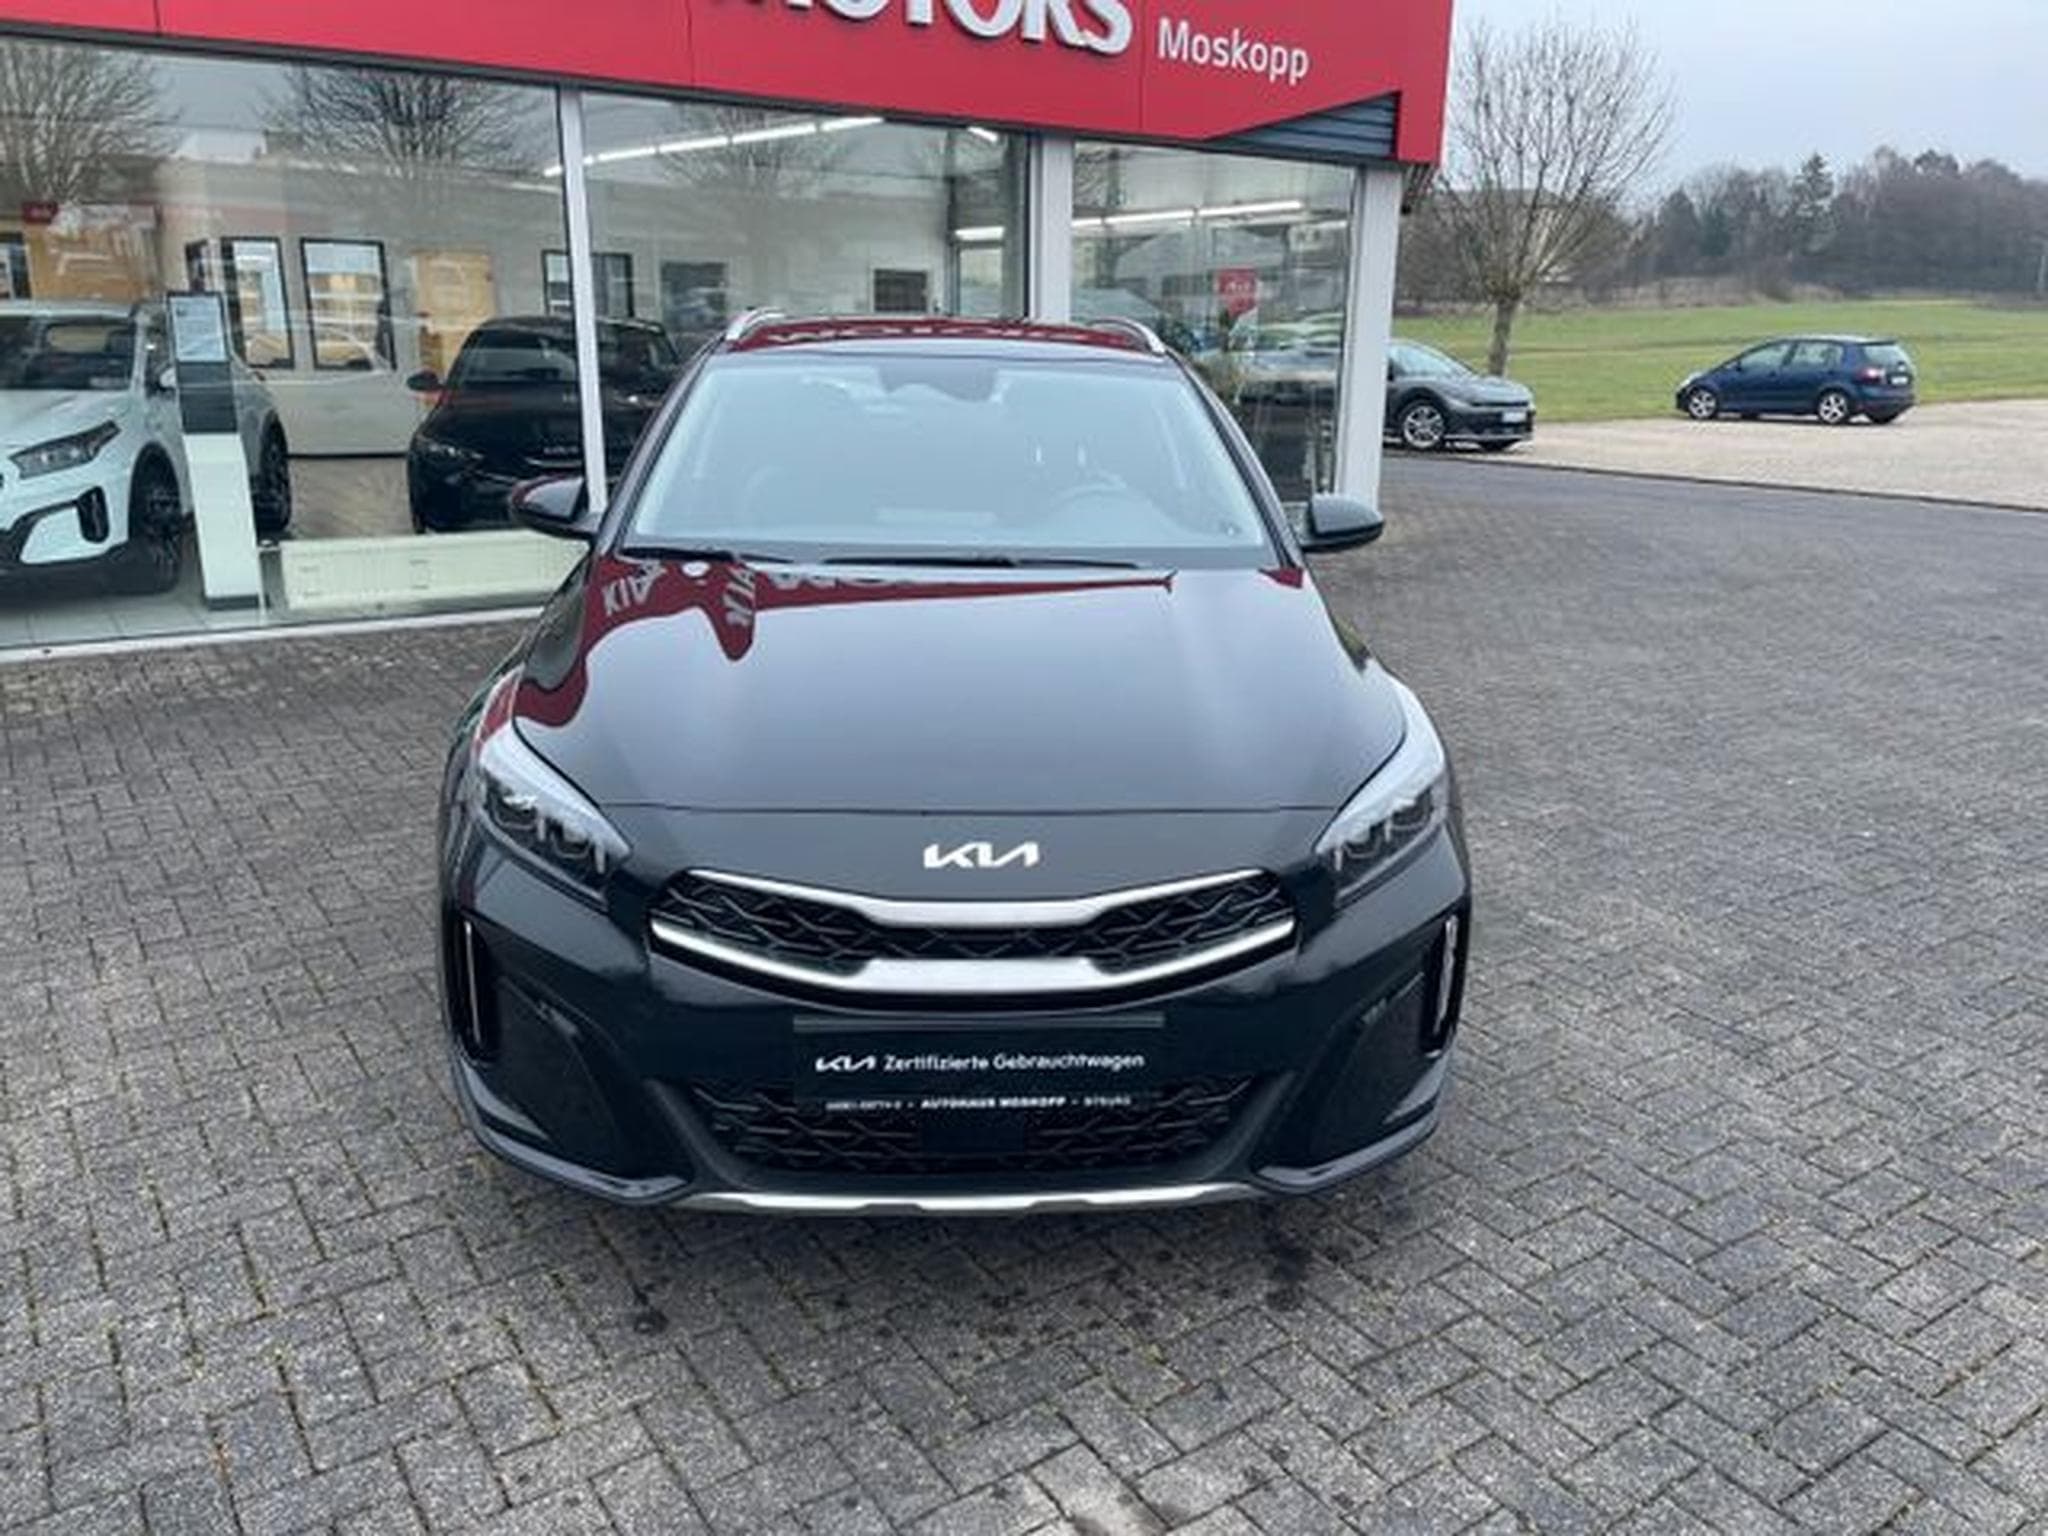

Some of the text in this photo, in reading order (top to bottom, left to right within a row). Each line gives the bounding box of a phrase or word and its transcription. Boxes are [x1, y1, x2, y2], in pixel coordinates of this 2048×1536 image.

[1157, 18, 1309, 86] Moskopp
[924, 841, 1038, 868] KIA
[815, 1052, 1145, 1072] KIA Zertifizierte Gebrauchtwagen
